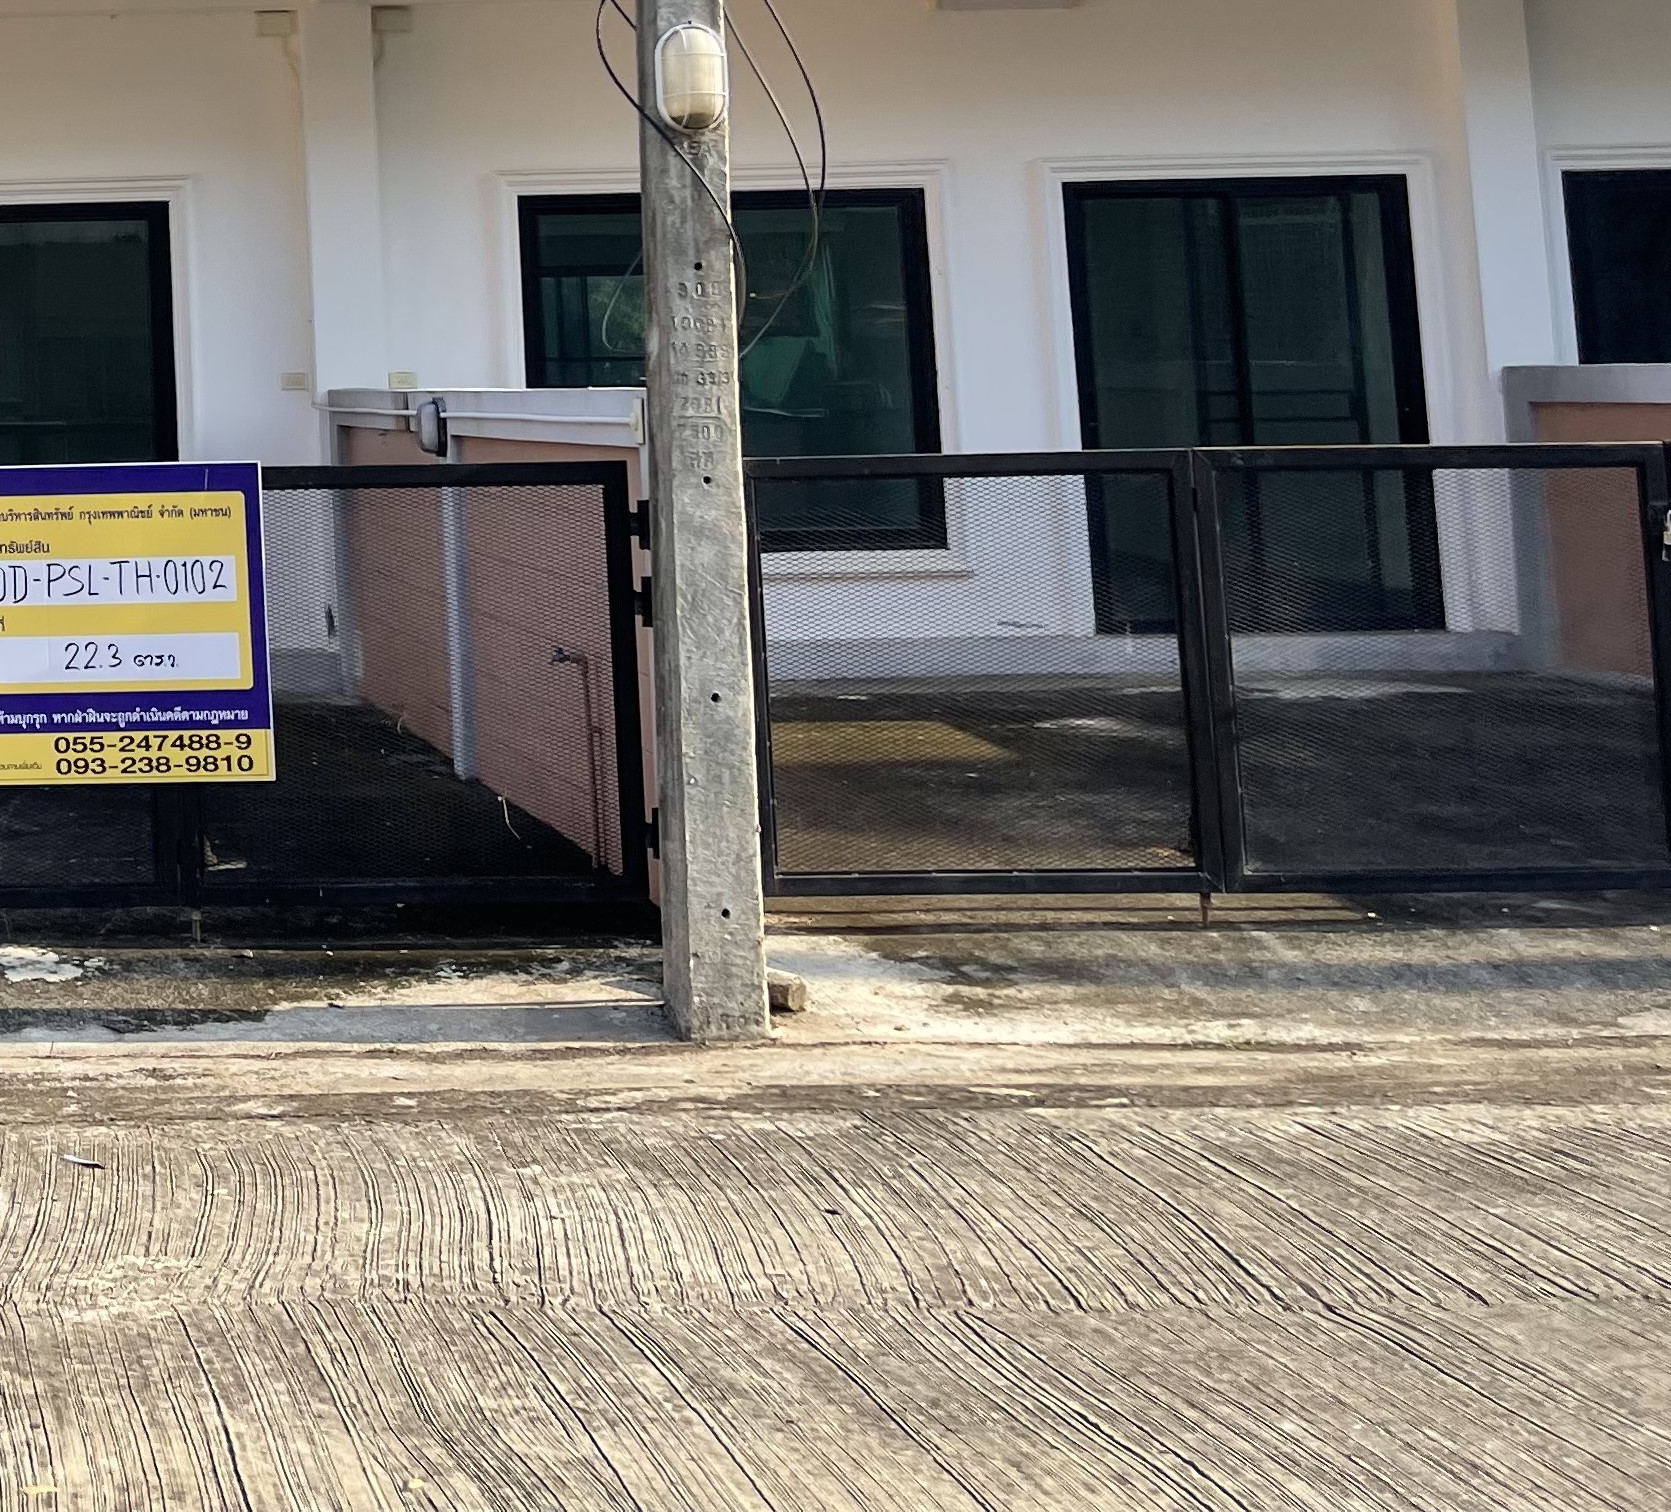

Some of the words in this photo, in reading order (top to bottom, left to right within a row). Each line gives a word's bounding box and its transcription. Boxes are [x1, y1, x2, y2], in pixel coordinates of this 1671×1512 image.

[158, 505, 184, 519] จำกัด
[189, 506, 232, 520] (มหาชน)
[64, 641, 123, 671] 22.3
[53, 732, 253, 754] 055-247488-9
[55, 754, 255, 776] 093-238-9810
